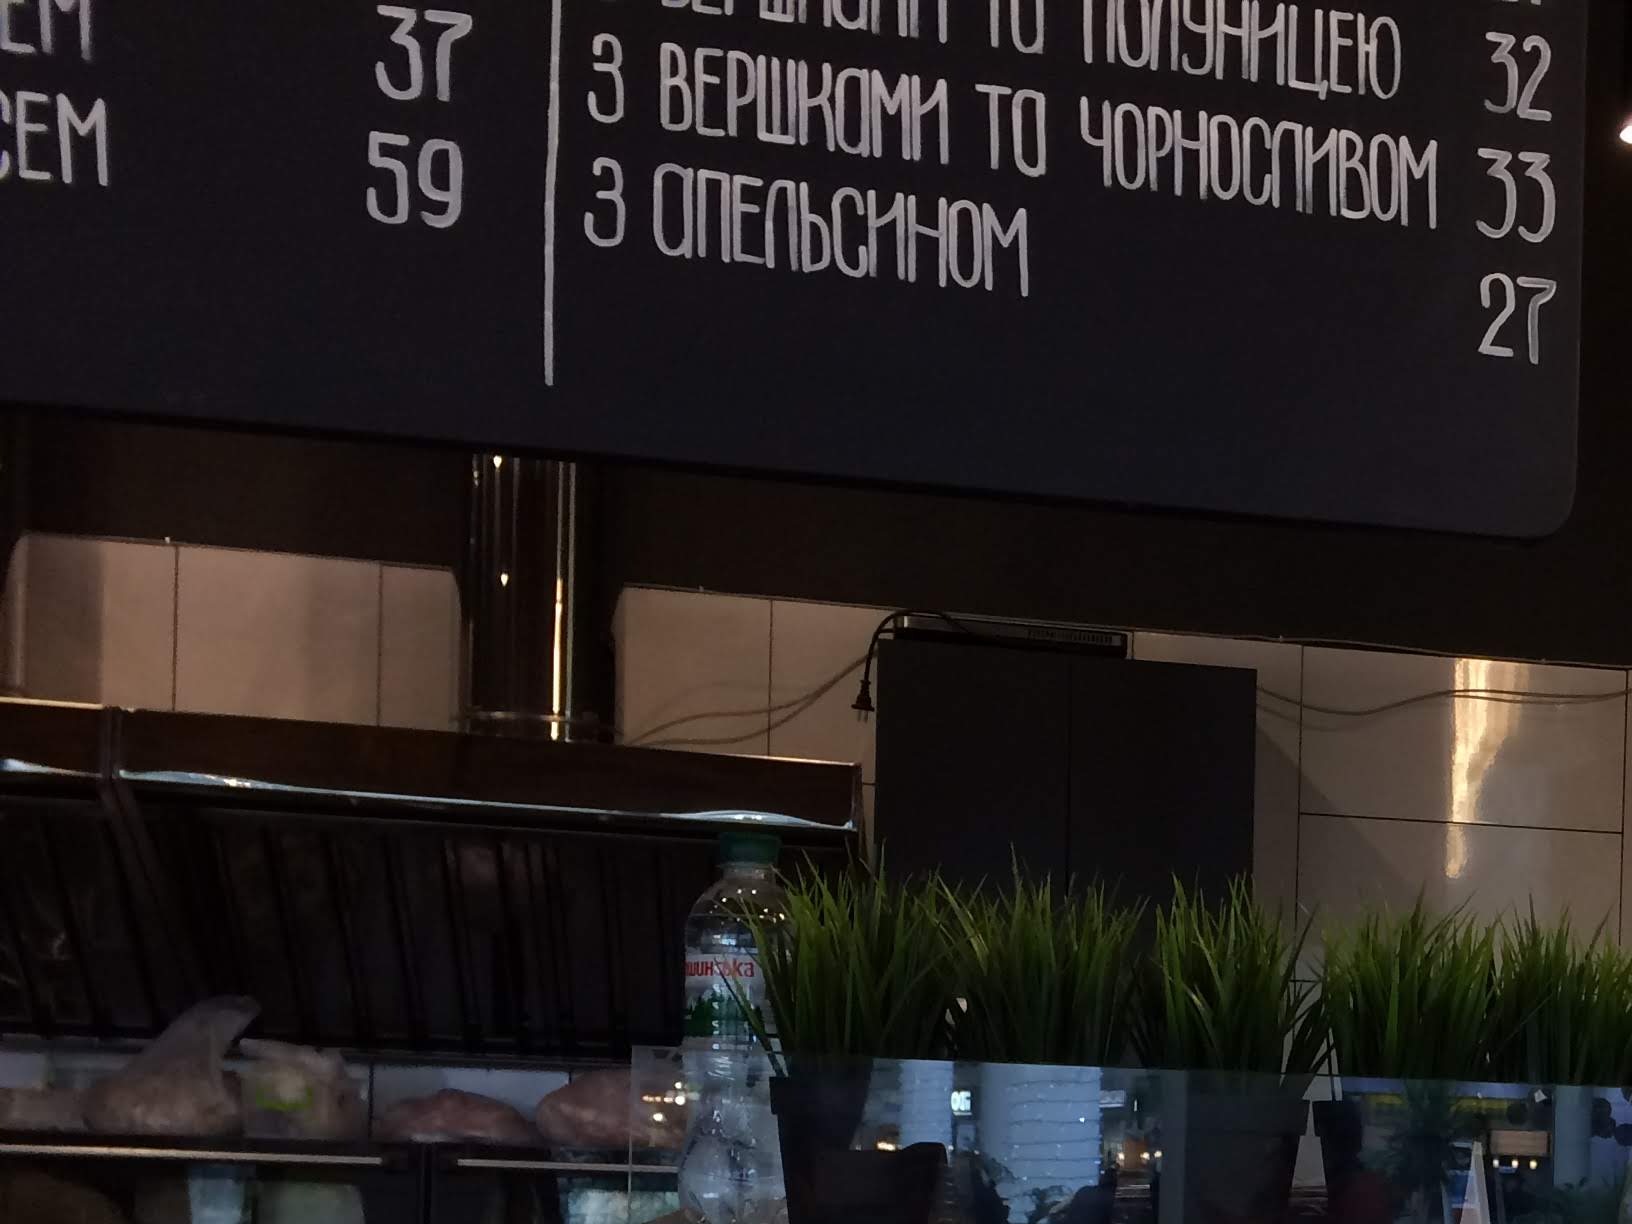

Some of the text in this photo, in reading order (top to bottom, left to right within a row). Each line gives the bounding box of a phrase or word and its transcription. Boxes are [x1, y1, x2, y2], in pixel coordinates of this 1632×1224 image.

[375, 5, 473, 102] 37
[1484, 32, 1552, 121] 32
[367, 131, 463, 228] 59
[660, 42, 949, 164] ВЕРШКАМИ
[975, 84, 1046, 177] ТА
[1080, 96, 1438, 229] ЧОРНОСЛИВОМ
[1476, 148, 1556, 243] 33
[653, 163, 1028, 297] АПЕЛЬСИНОМ
[1478, 273, 1557, 364] 27
